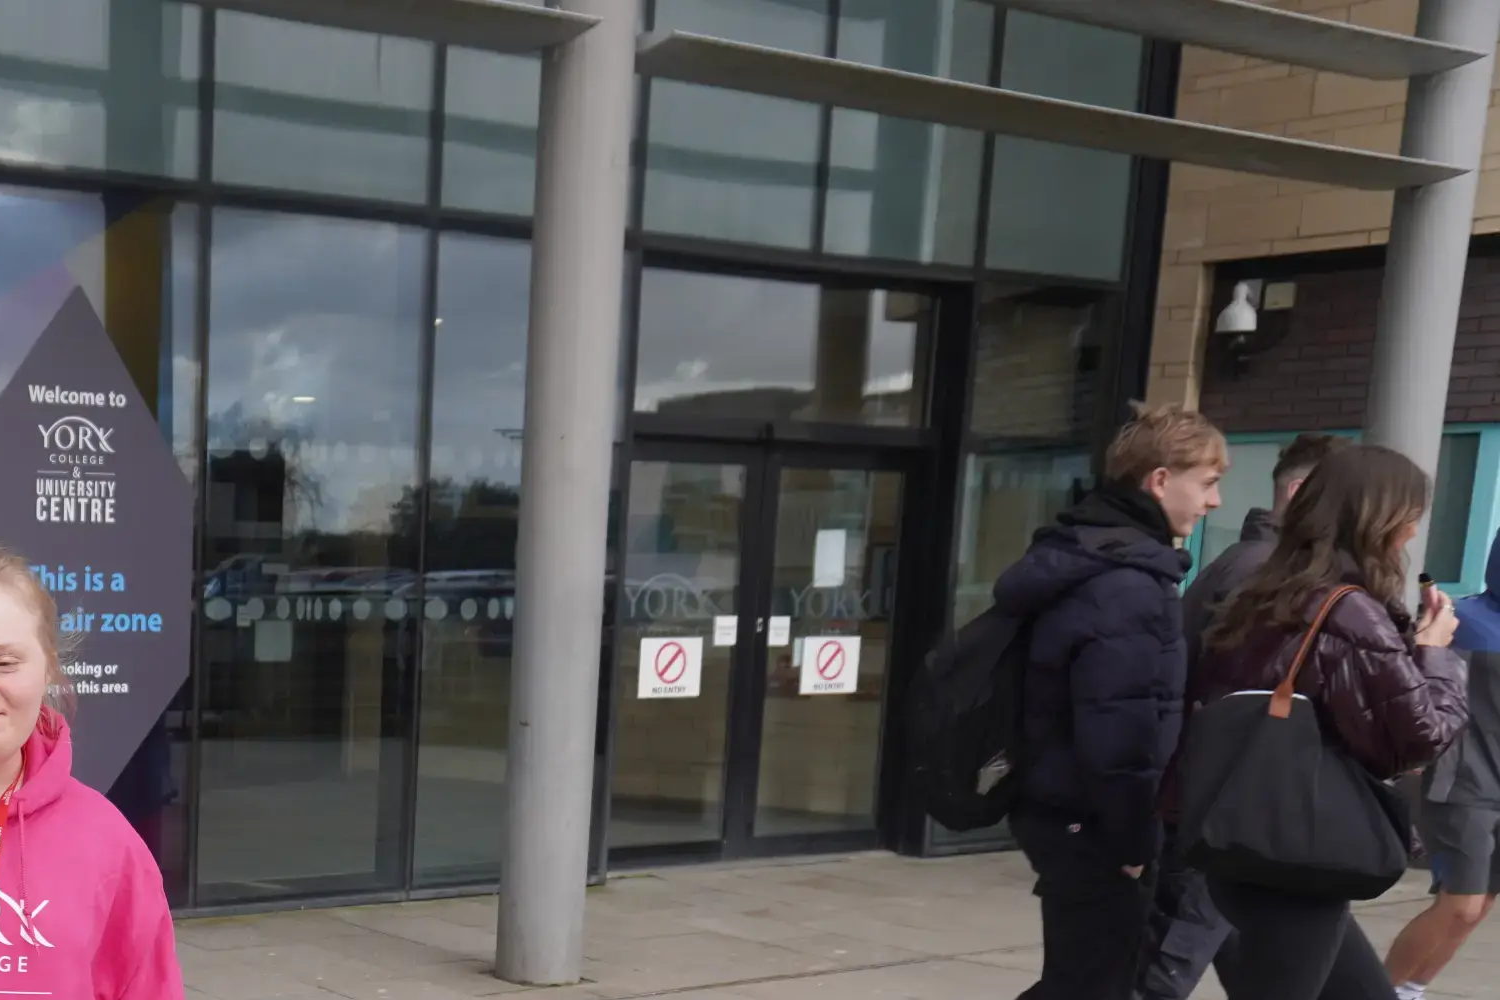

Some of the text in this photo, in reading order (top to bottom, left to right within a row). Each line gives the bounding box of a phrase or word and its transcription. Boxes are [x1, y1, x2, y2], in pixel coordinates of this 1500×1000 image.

[28, 384, 127, 407] Welcome to
[37, 416, 116, 453] YORK
[49, 454, 104, 465] COLLEGE
[72, 466, 81, 478] &
[36, 478, 117, 497] UNIVERSITY
[36, 496, 116, 523] CENTRE
[84, 565, 104, 592] is
[110, 572, 126, 592] a
[624, 573, 723, 619] YORK
[790, 577, 872, 619] YORK
[60, 607, 163, 632] air zone
[104, 664, 118, 676] or
[76, 680, 100, 693] this
[102, 682, 129, 693] area
[652, 685, 687, 694] NO ENTRY
